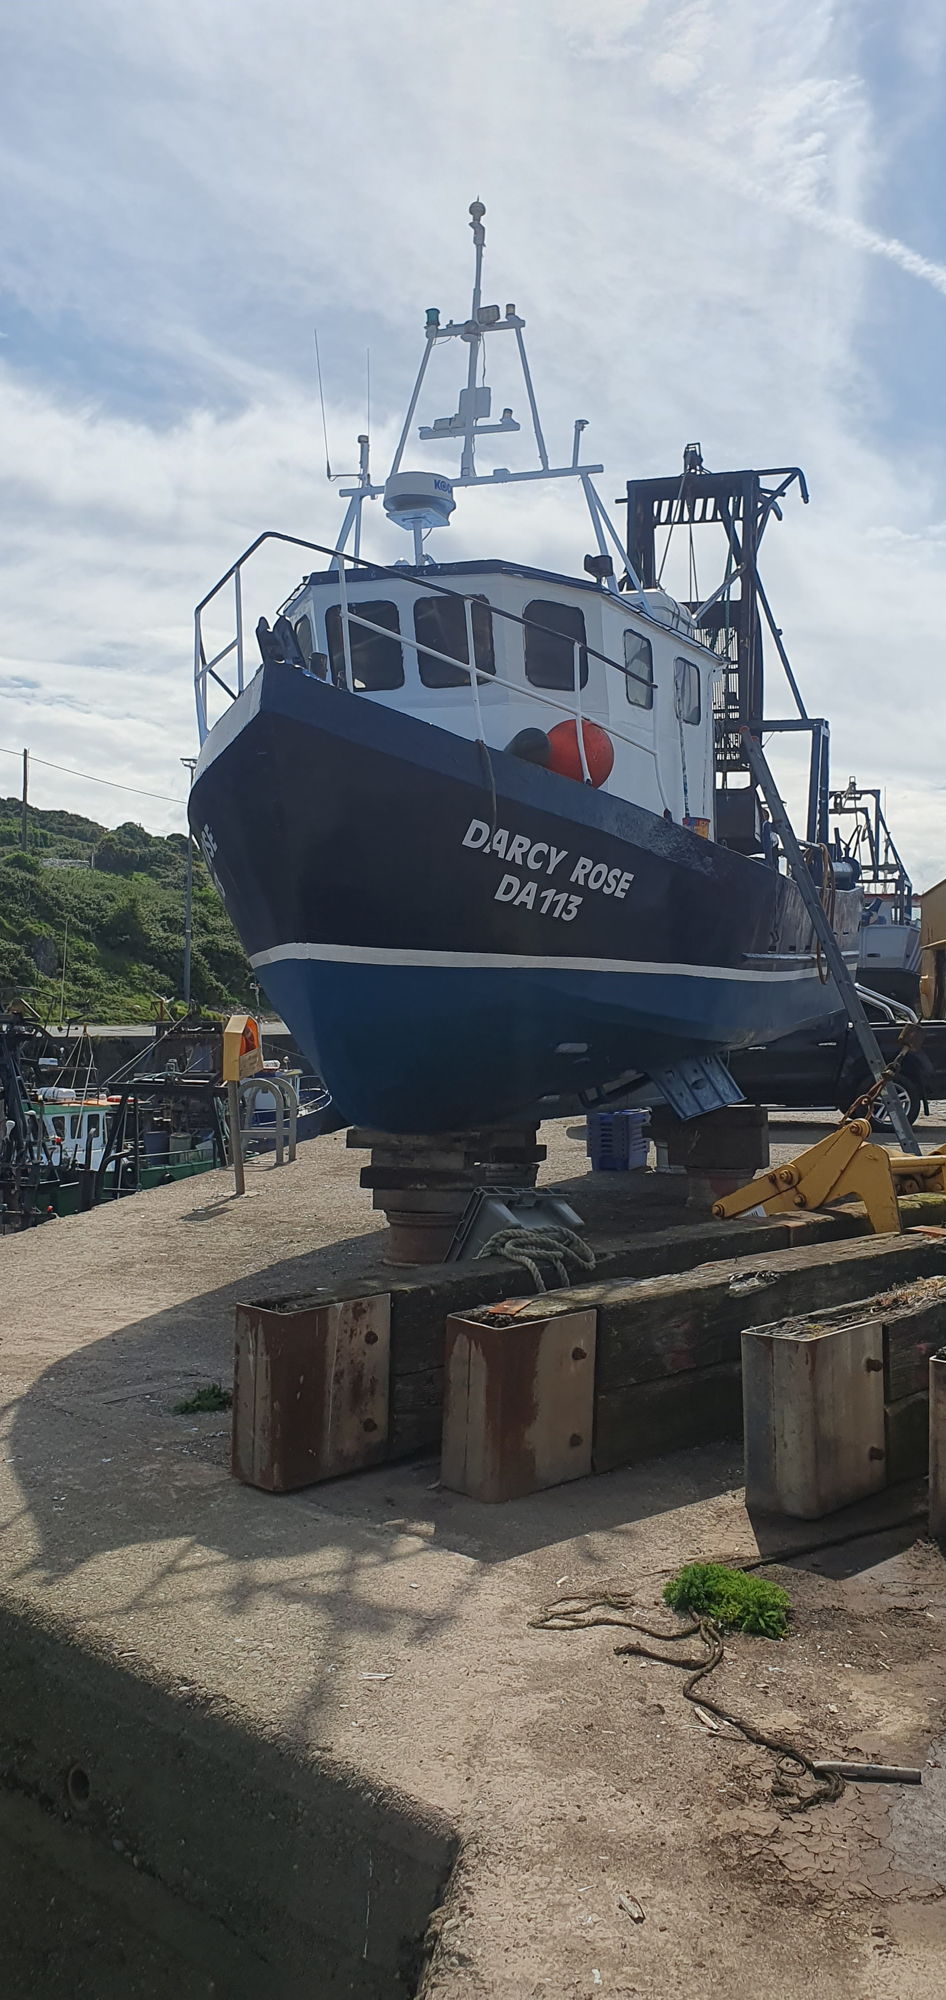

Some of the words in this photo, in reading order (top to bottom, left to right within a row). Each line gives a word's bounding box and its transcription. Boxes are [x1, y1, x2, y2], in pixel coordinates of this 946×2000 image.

[461, 818, 568, 875] DARCY
[569, 856, 635, 899] ROSE
[494, 873, 584, 922] DA113
